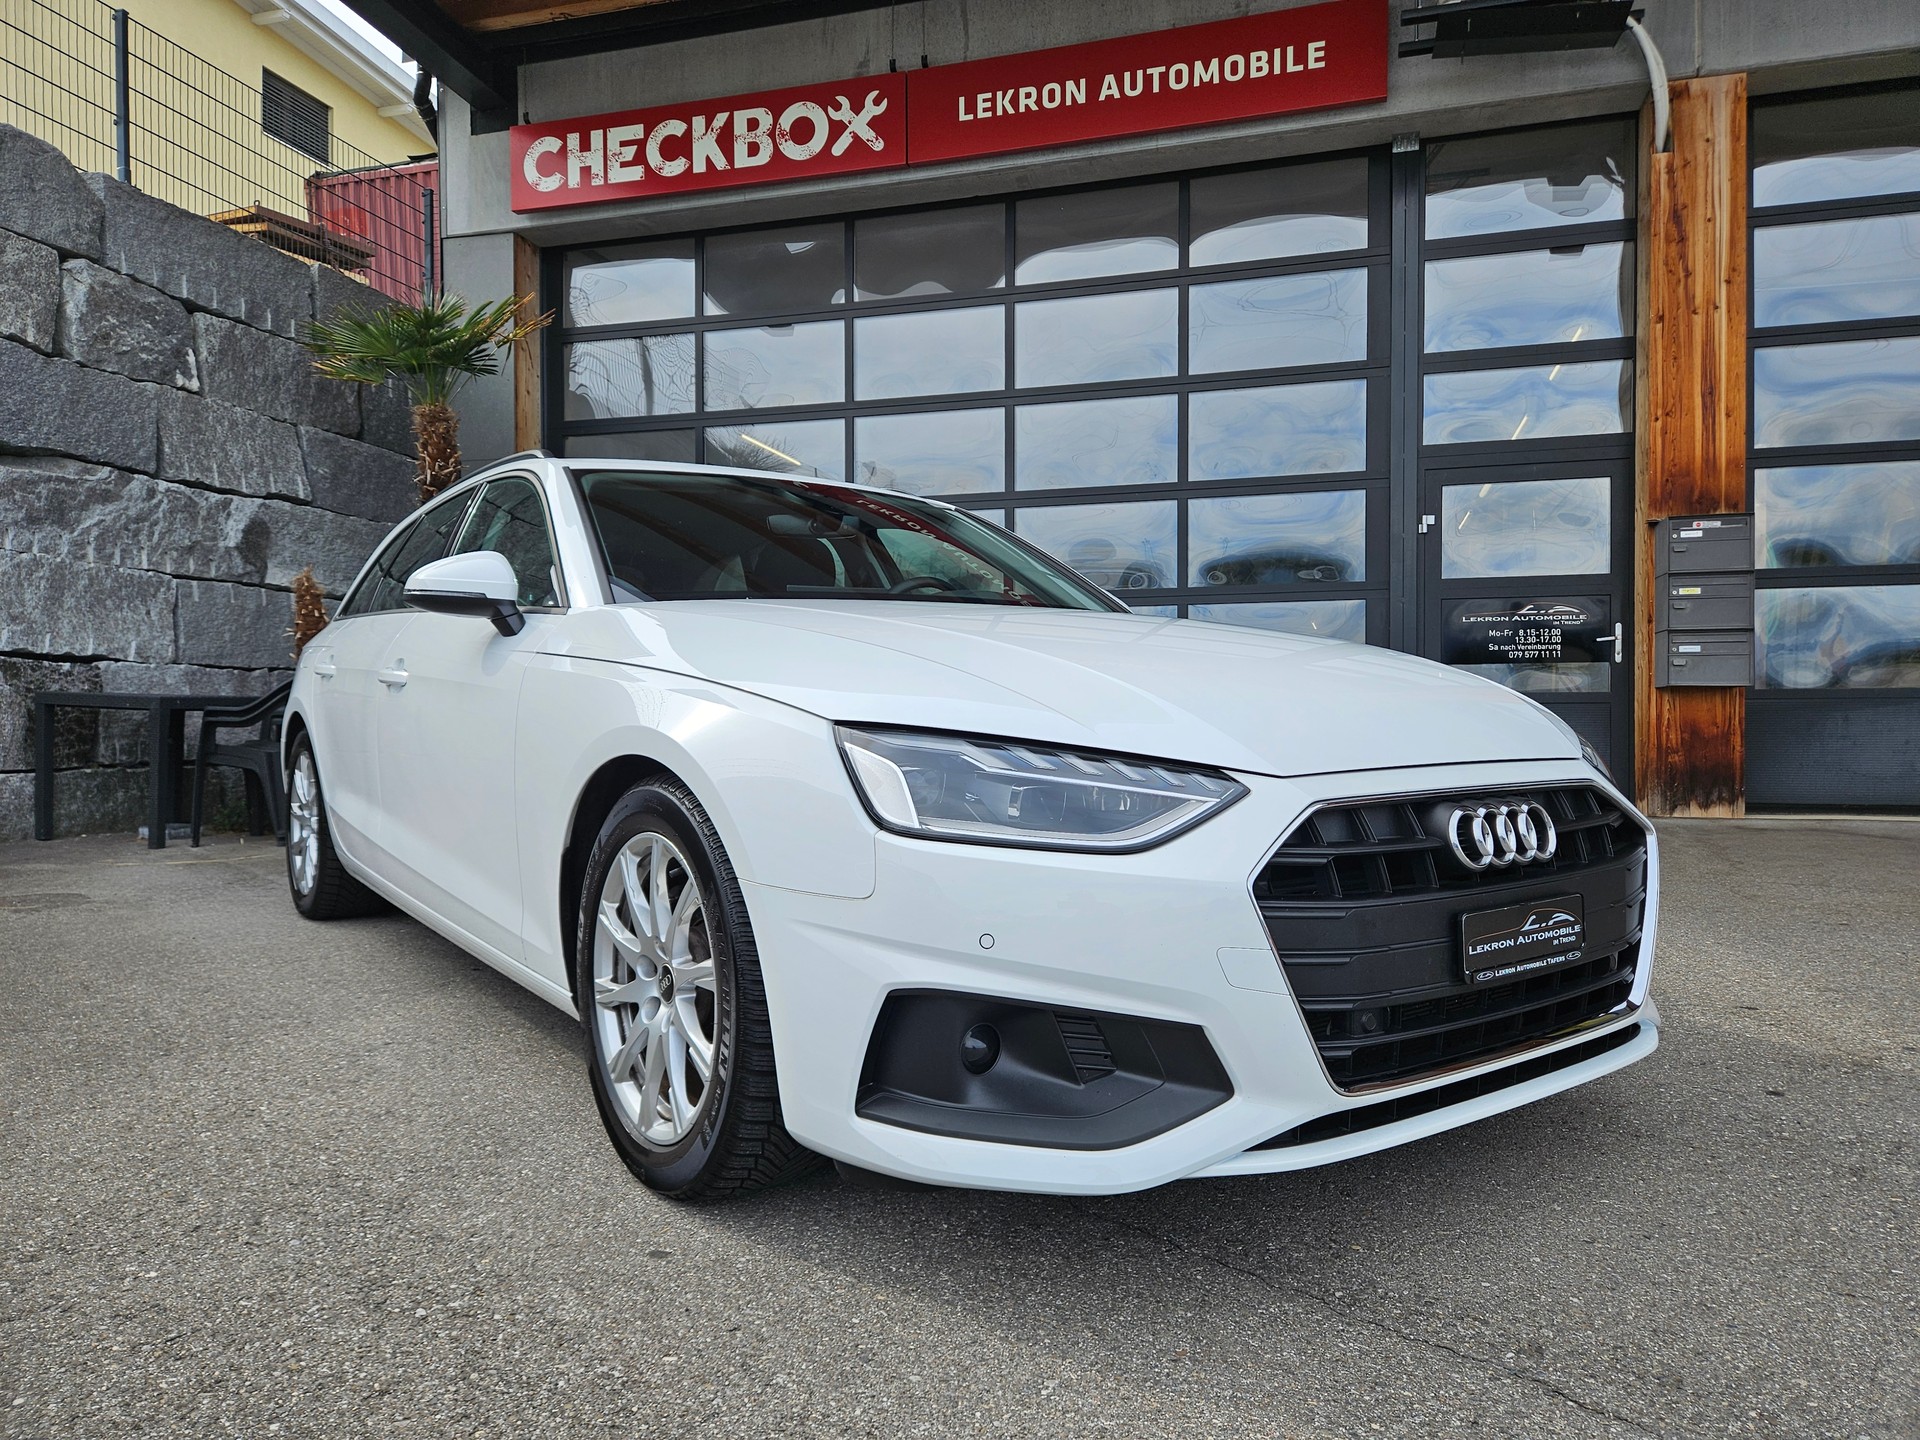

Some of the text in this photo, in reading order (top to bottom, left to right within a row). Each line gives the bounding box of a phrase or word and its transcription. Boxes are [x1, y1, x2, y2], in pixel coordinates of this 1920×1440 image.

[957, 39, 1327, 123] LEKRON AUTOMOBILE
[522, 89, 889, 193] CHECKBOX
[1488, 628, 1562, 637] Mo-Fr 8.15-12.00
[1488, 643, 1499, 651] Sa
[1516, 643, 1561, 651] Vereinbarung
[1508, 651, 1524, 659] 079
[1469, 925, 1581, 955] LEKRON AUTOMOBILE
